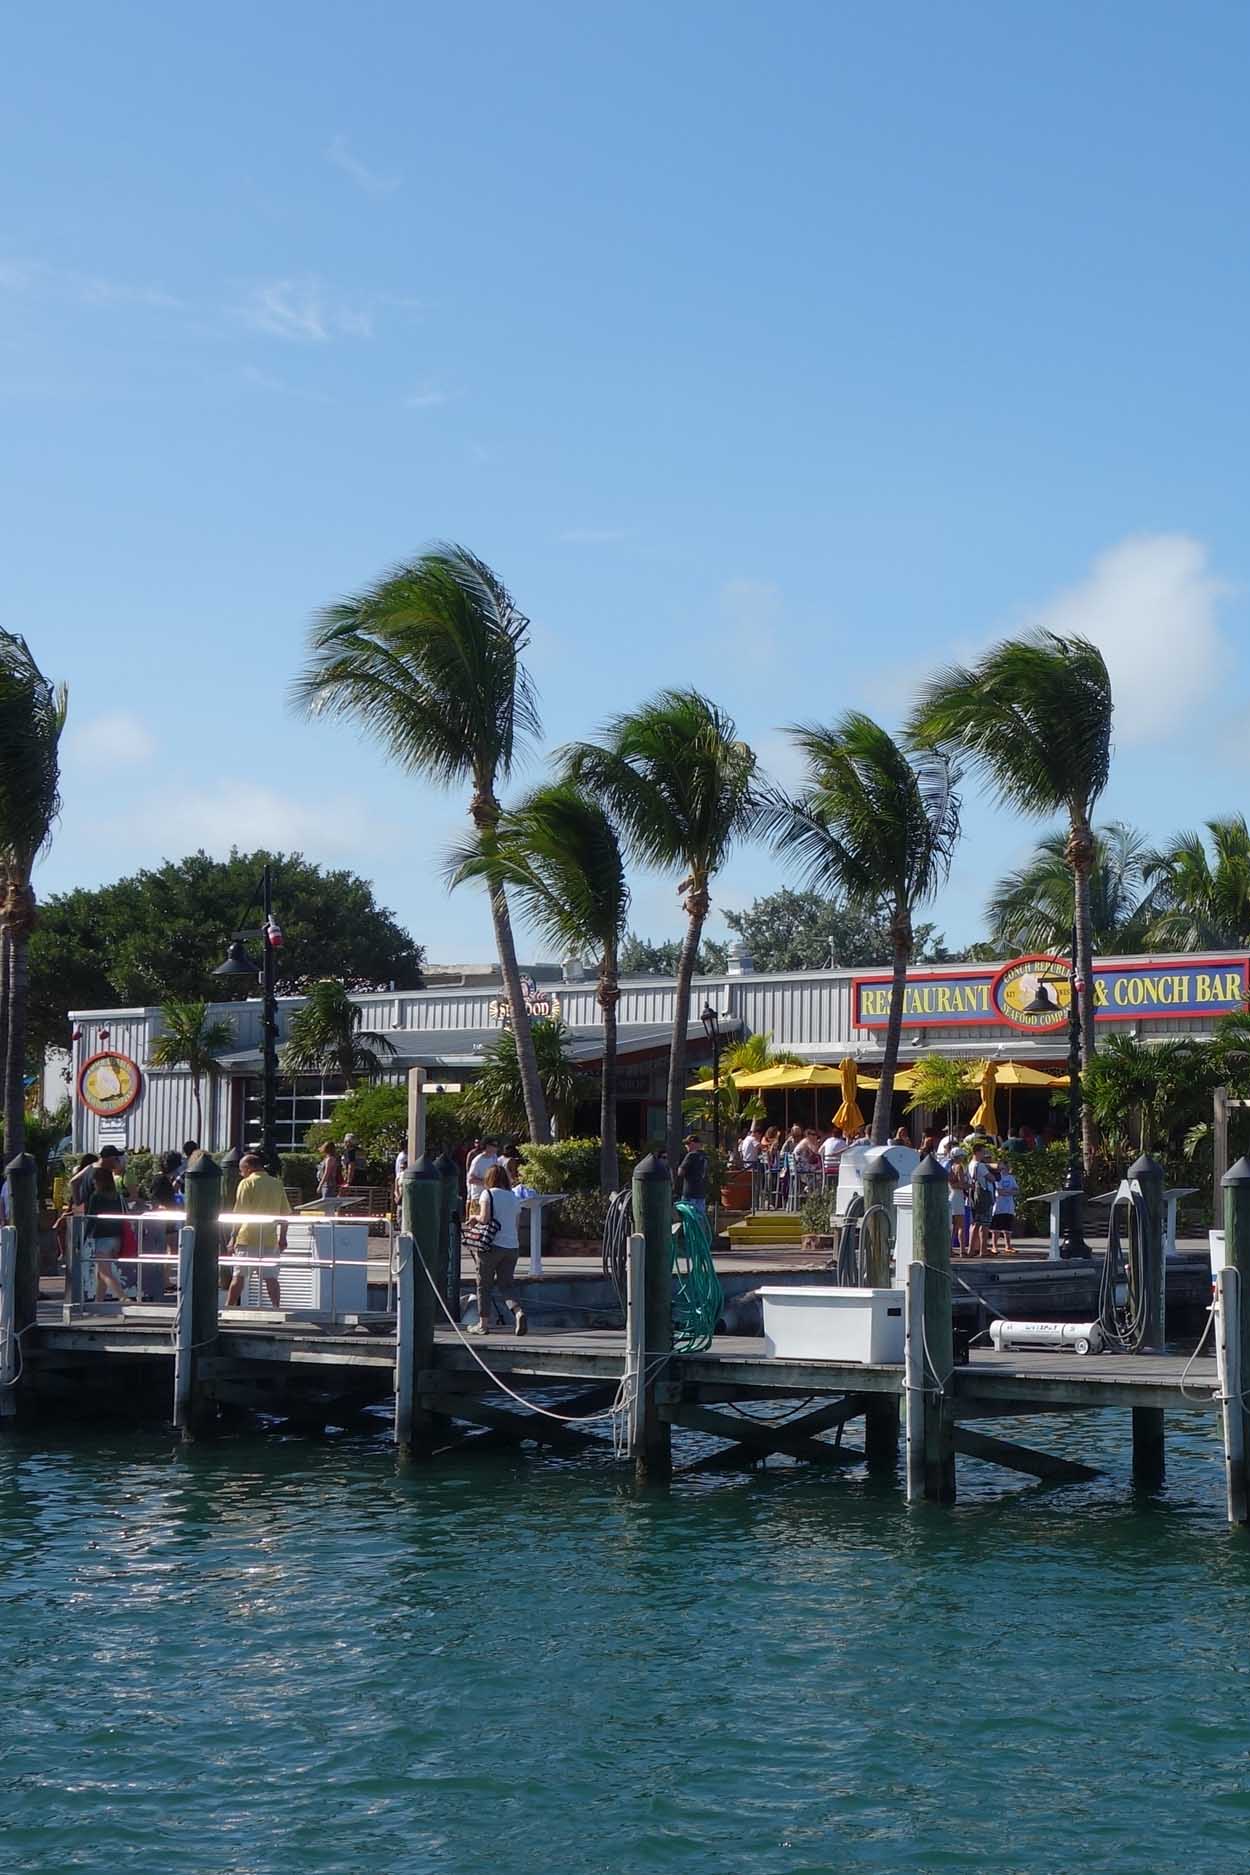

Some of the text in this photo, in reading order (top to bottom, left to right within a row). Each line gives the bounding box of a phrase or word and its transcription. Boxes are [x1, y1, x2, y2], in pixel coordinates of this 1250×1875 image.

[1003, 961, 1071, 984] CONCH REPUBLI
[1094, 973, 1242, 1007] & CONCH BAR
[1001, 1003, 1070, 1025] SEAFOOD COMPA
